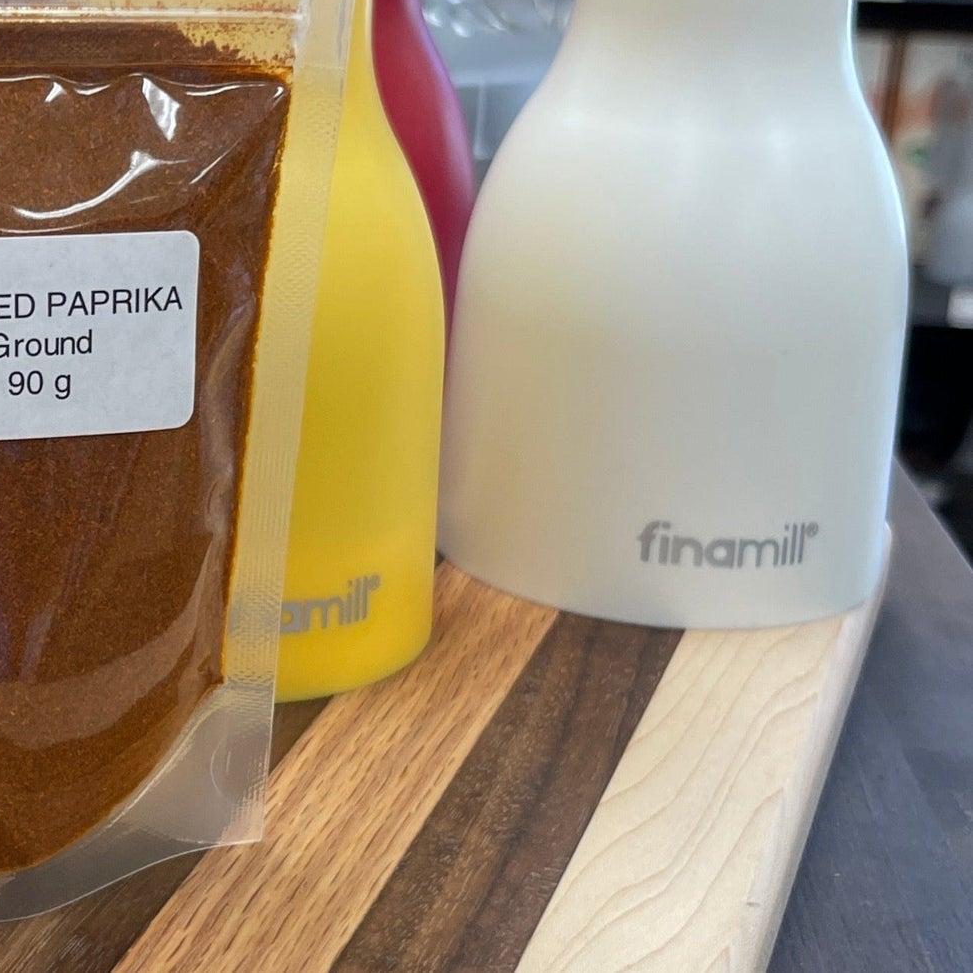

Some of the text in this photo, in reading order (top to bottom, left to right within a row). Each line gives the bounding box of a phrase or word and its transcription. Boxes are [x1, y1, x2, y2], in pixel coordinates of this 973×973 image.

[46, 285, 183, 317] PAPRIKA
[8, 370, 72, 400] 90 g
